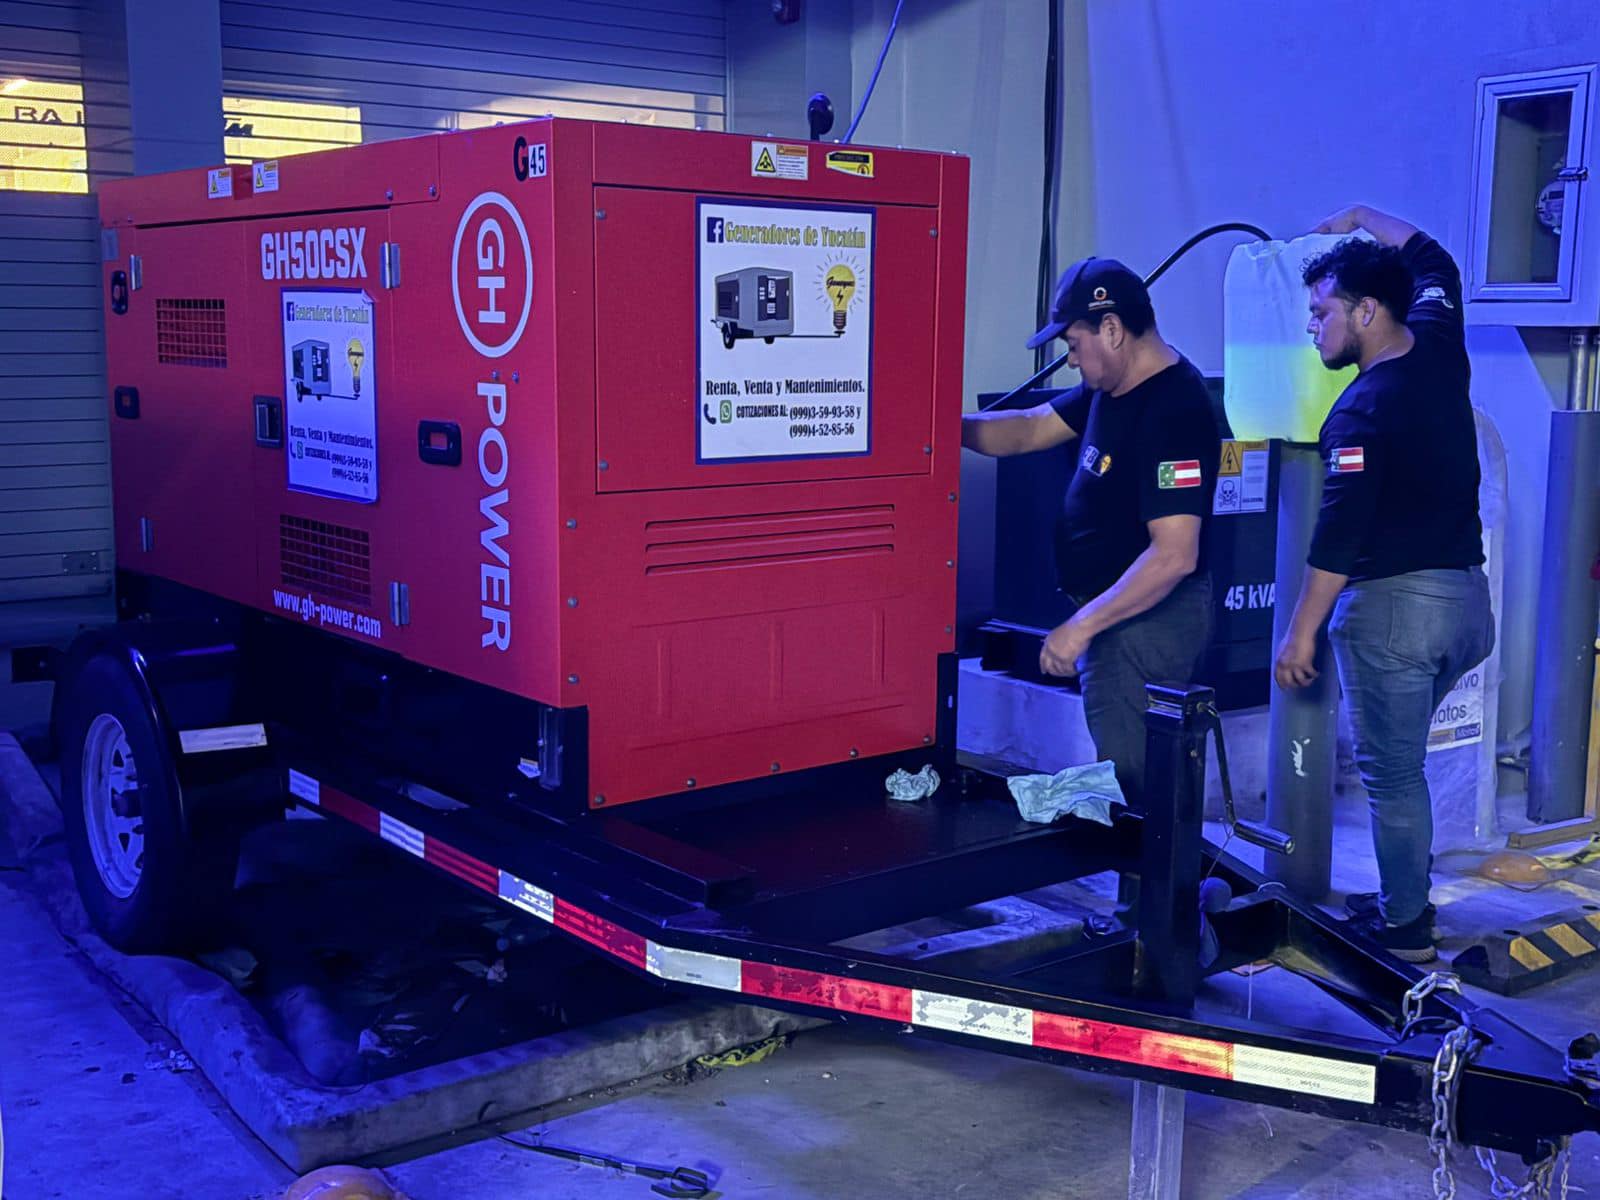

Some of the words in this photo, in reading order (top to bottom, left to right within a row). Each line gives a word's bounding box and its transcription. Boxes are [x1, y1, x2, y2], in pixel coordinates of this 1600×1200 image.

[15, 106, 82, 125] RA
[725, 221, 800, 246] Generadores
[803, 225, 818, 246] de
[821, 225, 866, 249] Yucatán
[260, 227, 368, 280] GH50CSX
[477, 217, 506, 324] GH
[705, 380, 741, 396] Renta,
[744, 379, 773, 395] Venta
[776, 382, 782, 396] y
[785, 379, 865, 394] Mantenimientos.
[736, 404, 779, 418] COTIZACIONES
[477, 382, 511, 652] POWER
[1225, 585, 1245, 611] 45
[1248, 582, 1277, 609] kVA
[273, 589, 381, 639] www.gh-power.com
